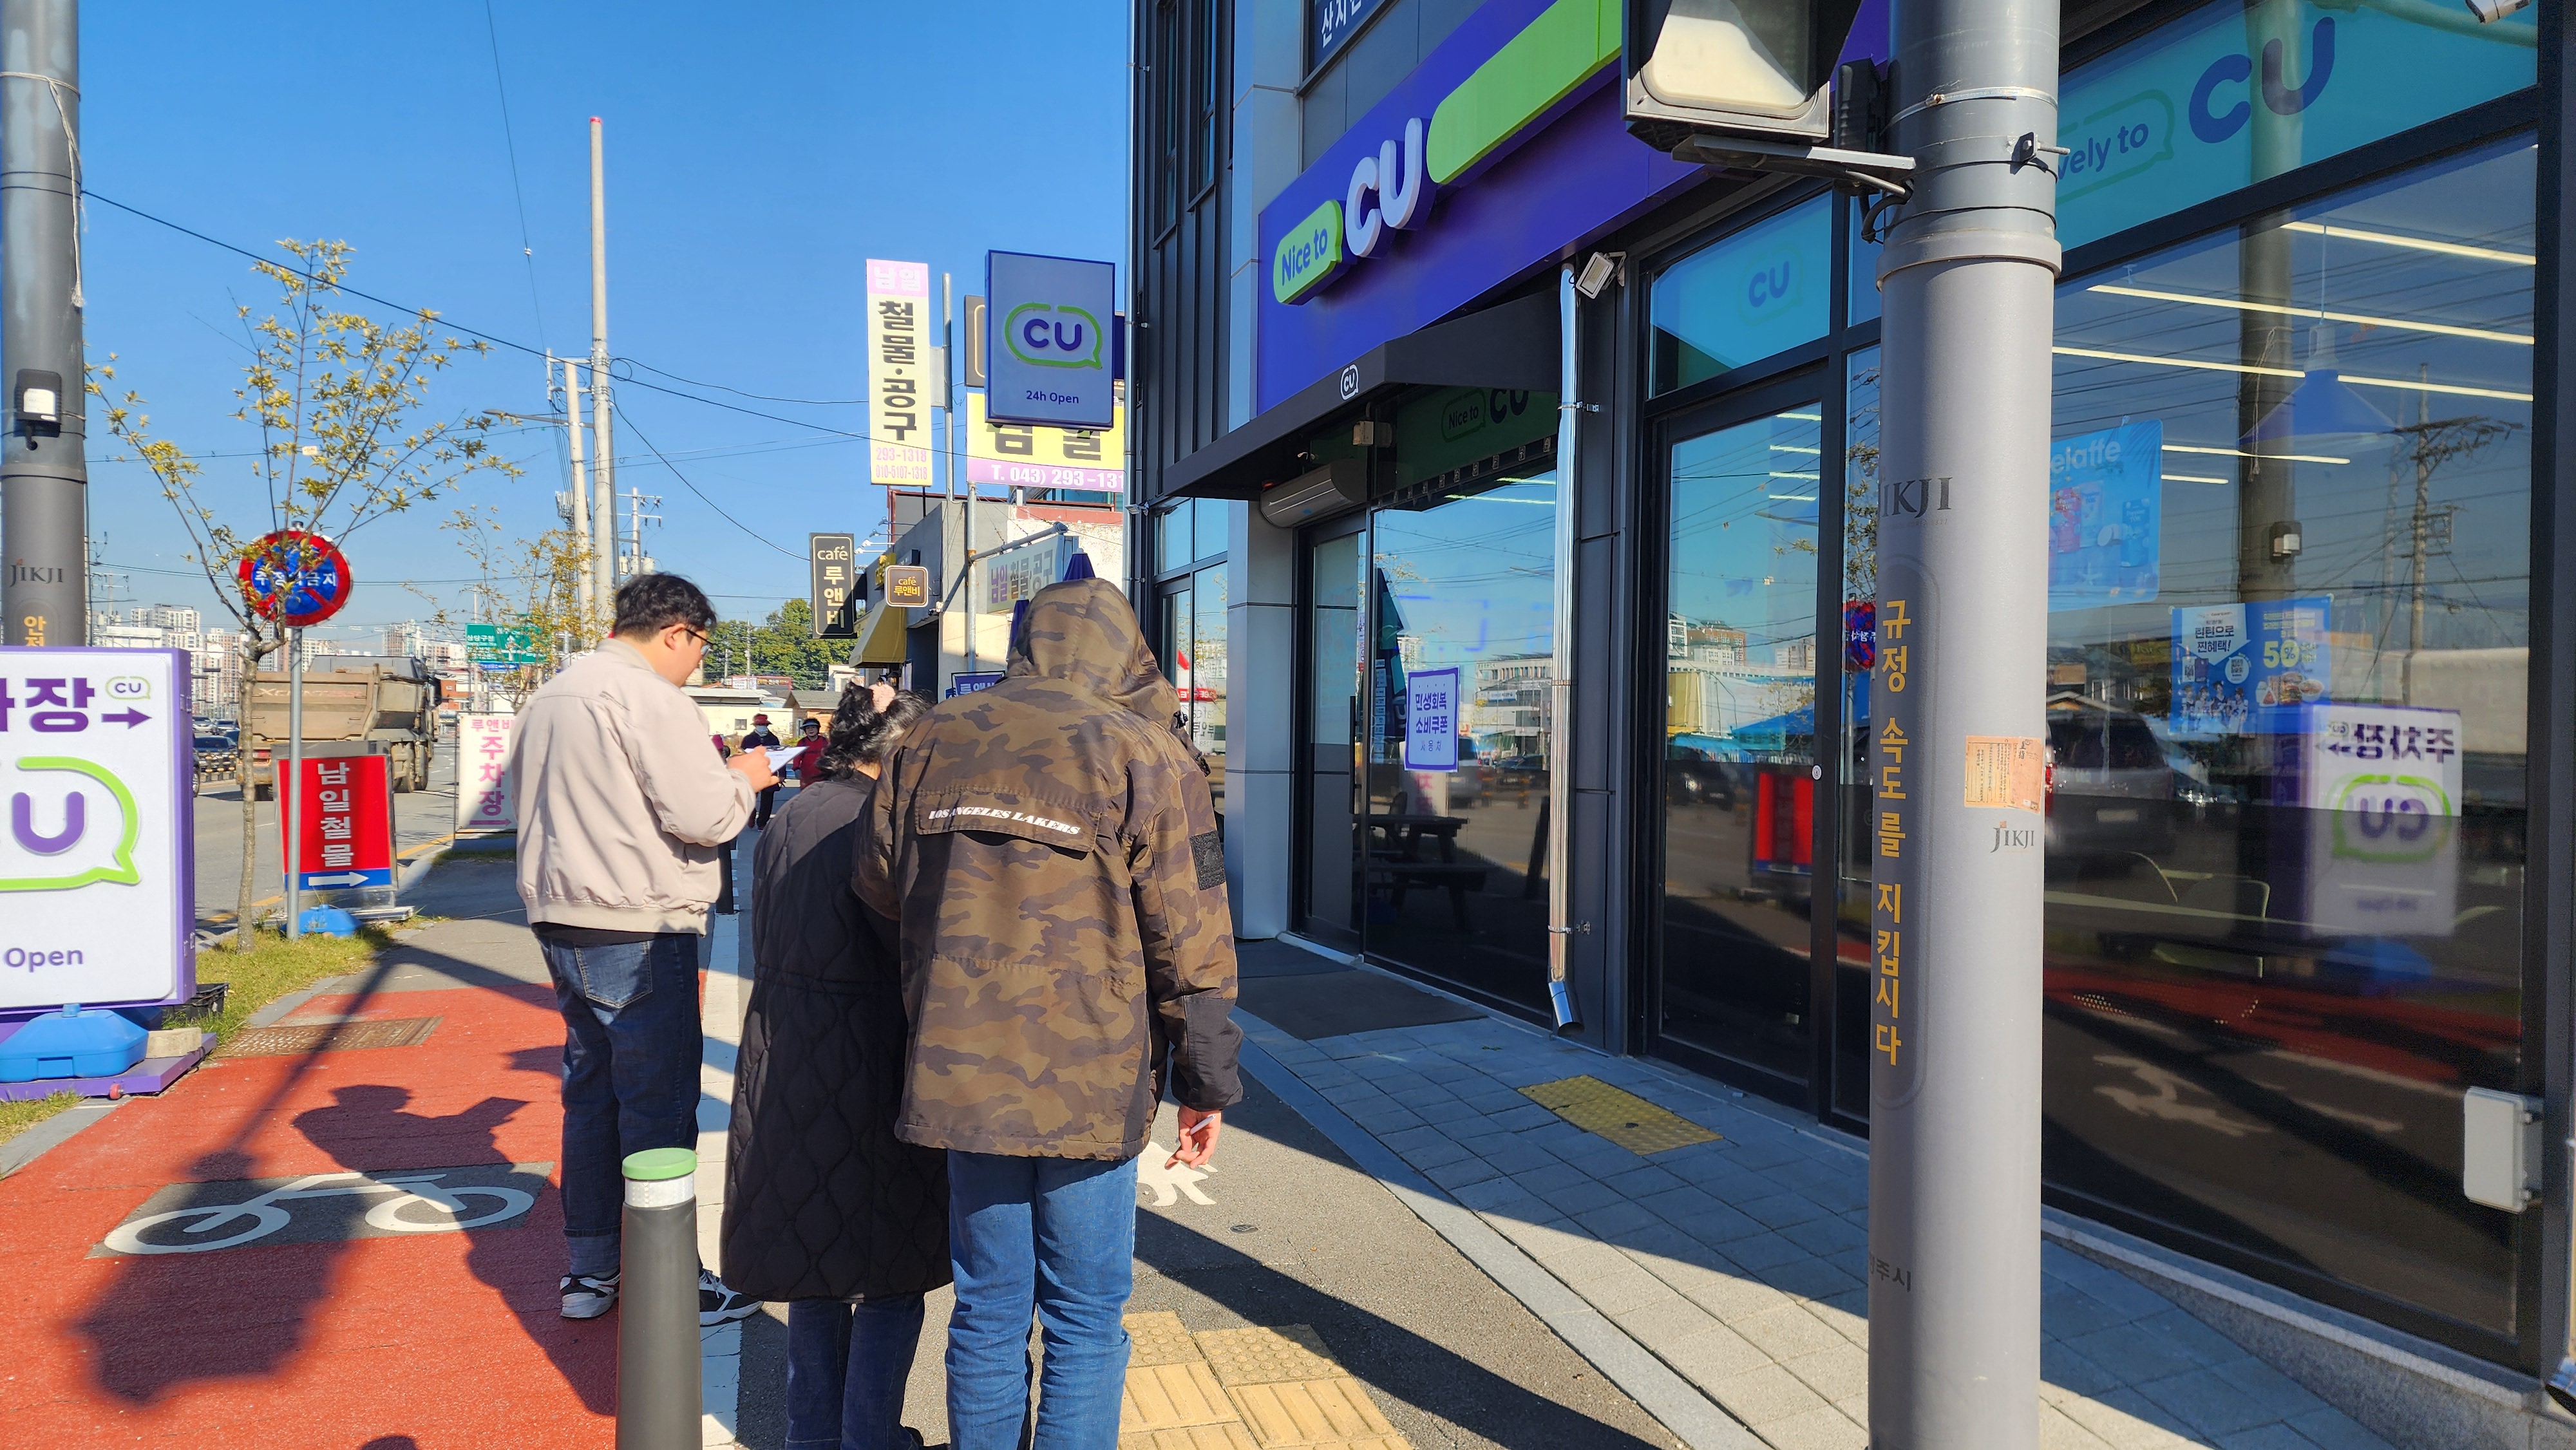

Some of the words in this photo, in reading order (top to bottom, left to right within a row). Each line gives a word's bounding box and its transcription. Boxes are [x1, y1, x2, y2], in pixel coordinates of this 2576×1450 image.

[2058, 138, 2111, 180] vely
[2117, 124, 2149, 154] to
[2190, 17, 2335, 144] CU
[1282, 242, 1311, 287] Nice
[1314, 229, 1328, 260] to
[1345, 117, 1423, 258] CU
[875, 266, 921, 292] 남일
[1748, 261, 1790, 308] CU
[1023, 318, 1083, 352] CU
[1344, 372, 1356, 392] CU
[1026, 390, 1046, 402] 24h
[1049, 392, 1079, 404] Open
[1449, 412, 1468, 430] Nice
[1470, 405, 1479, 420] to
[1490, 388, 1529, 424] CU
[876, 447, 927, 462] 293-1318
[2050, 438, 2121, 475] elaffe
[876, 464, 927, 480] 010-5107-1318
[991, 464, 1004, 481] T.
[1010, 467, 1046, 484] 043)
[1051, 469, 1123, 488] 293-131
[1879, 477, 1953, 518] IKJI
[817, 546, 848, 560] café
[9, 564, 64, 588] JIKJI
[255, 570, 336, 587] 주정금지
[898, 576, 917, 586] café
[990, 564, 1008, 604] 남일
[823, 566, 845, 628] 루앤비
[893, 585, 921, 597] 루앤비
[1882, 600, 1911, 692] 규정
[114, 683, 142, 693] CU
[1415, 692, 1447, 711] 민생회복
[1416, 715, 1448, 734] 소비쿠폰
[478, 737, 506, 816] 주차장
[1878, 717, 1908, 858] 속도를
[11, 791, 85, 857] U
[317, 762, 354, 867] 남일철물
[928, 809, 949, 820] LOS
[949, 807, 1011, 819] ANGELES
[1011, 812, 1081, 834] LAKERS
[1990, 827, 2034, 853] JIKJI
[4, 947, 84, 974] Open
[1875, 883, 1902, 1066] 지킵시다
[1869, 1249, 1911, 1293] 주시
